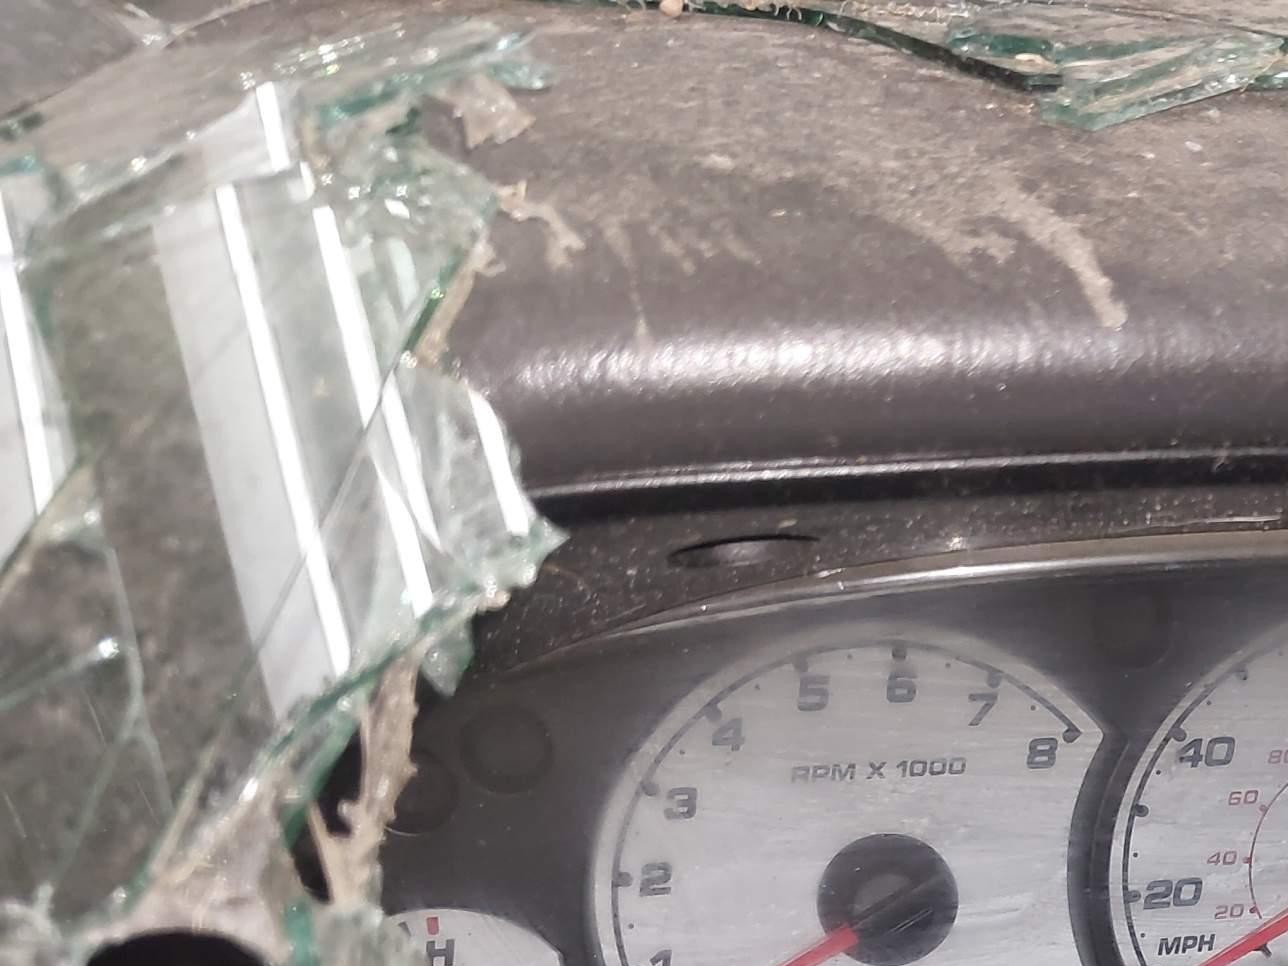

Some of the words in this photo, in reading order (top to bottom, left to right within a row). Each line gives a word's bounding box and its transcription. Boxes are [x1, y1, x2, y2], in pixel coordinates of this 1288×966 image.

[798, 675, 830, 711] 5
[886, 671, 917, 704] 6
[967, 692, 999, 727] 7
[711, 718, 746, 752] 4
[1026, 737, 1058, 769] 8
[1180, 737, 1236, 768] 40
[791, 764, 857, 783] RPM
[865, 763, 887, 779] X
[896, 757, 967, 778] 1000
[662, 786, 697, 820] 3
[1228, 789, 1259, 806] 60
[1206, 850, 1238, 866] 40
[638, 861, 672, 896] 2
[1142, 877, 1203, 910] 20
[1214, 903, 1244, 920] 20
[1157, 933, 1216, 956] MPH
